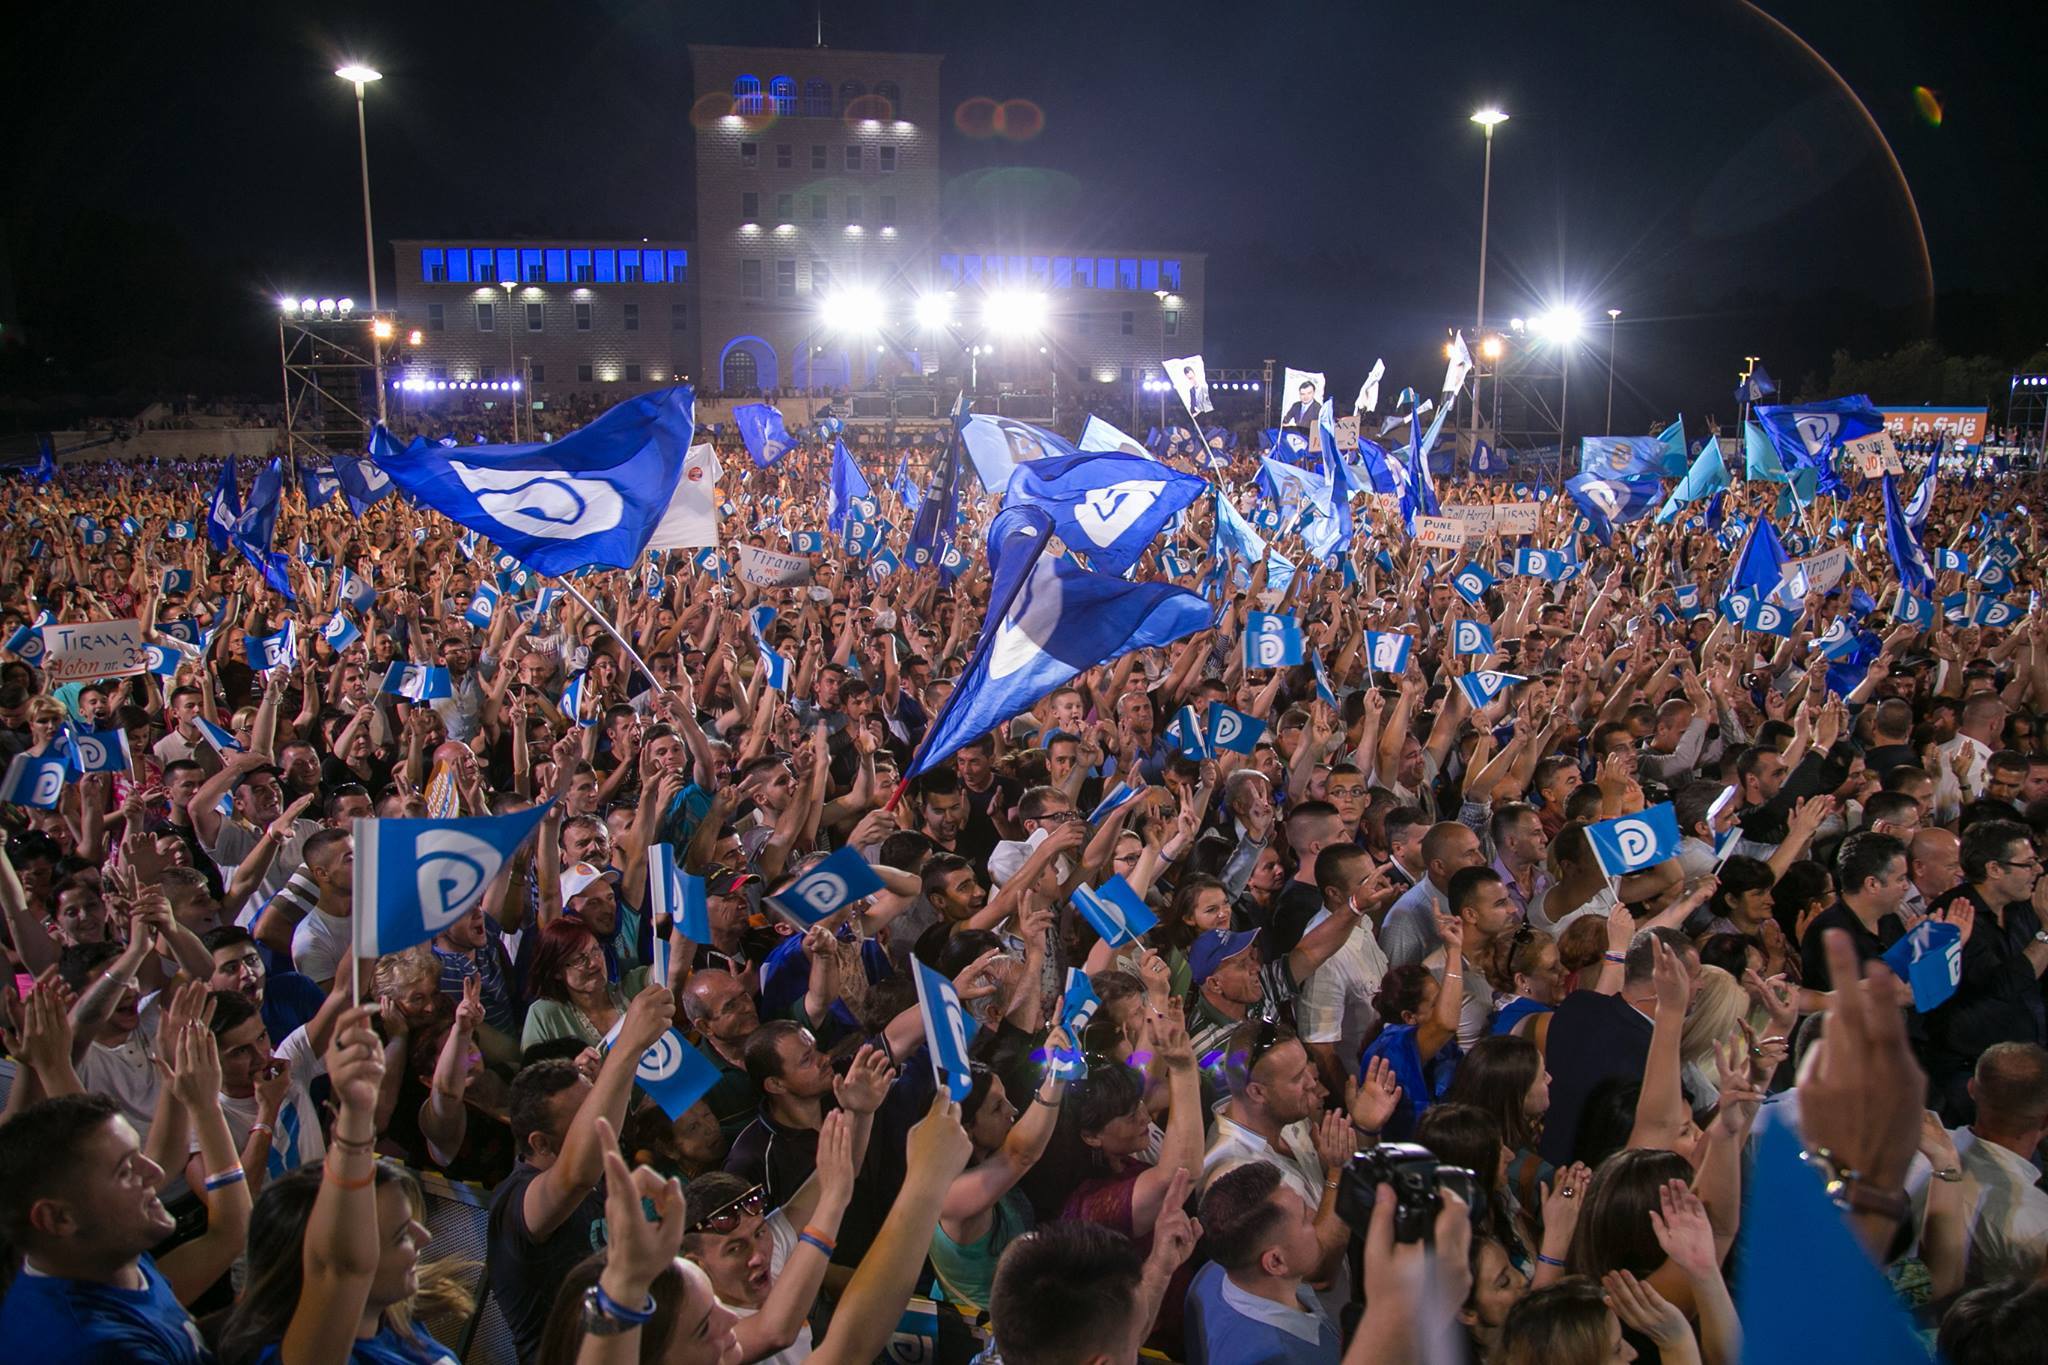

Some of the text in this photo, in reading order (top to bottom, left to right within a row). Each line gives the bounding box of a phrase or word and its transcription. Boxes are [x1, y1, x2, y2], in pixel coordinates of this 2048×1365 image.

[1909, 416, 1930, 438] jo
[1932, 416, 1976, 437] fjalë
[1347, 431, 1357, 446] 3
[1865, 455, 1878, 471] JO
[1502, 506, 1537, 519] TIRANA
[1423, 519, 1452, 530] PUNE
[1419, 530, 1436, 541] JO
[1436, 532, 1462, 544] FJALE
[752, 548, 802, 572] Tirana
[764, 567, 780, 577] ME
[58, 629, 134, 652] TIRANA
